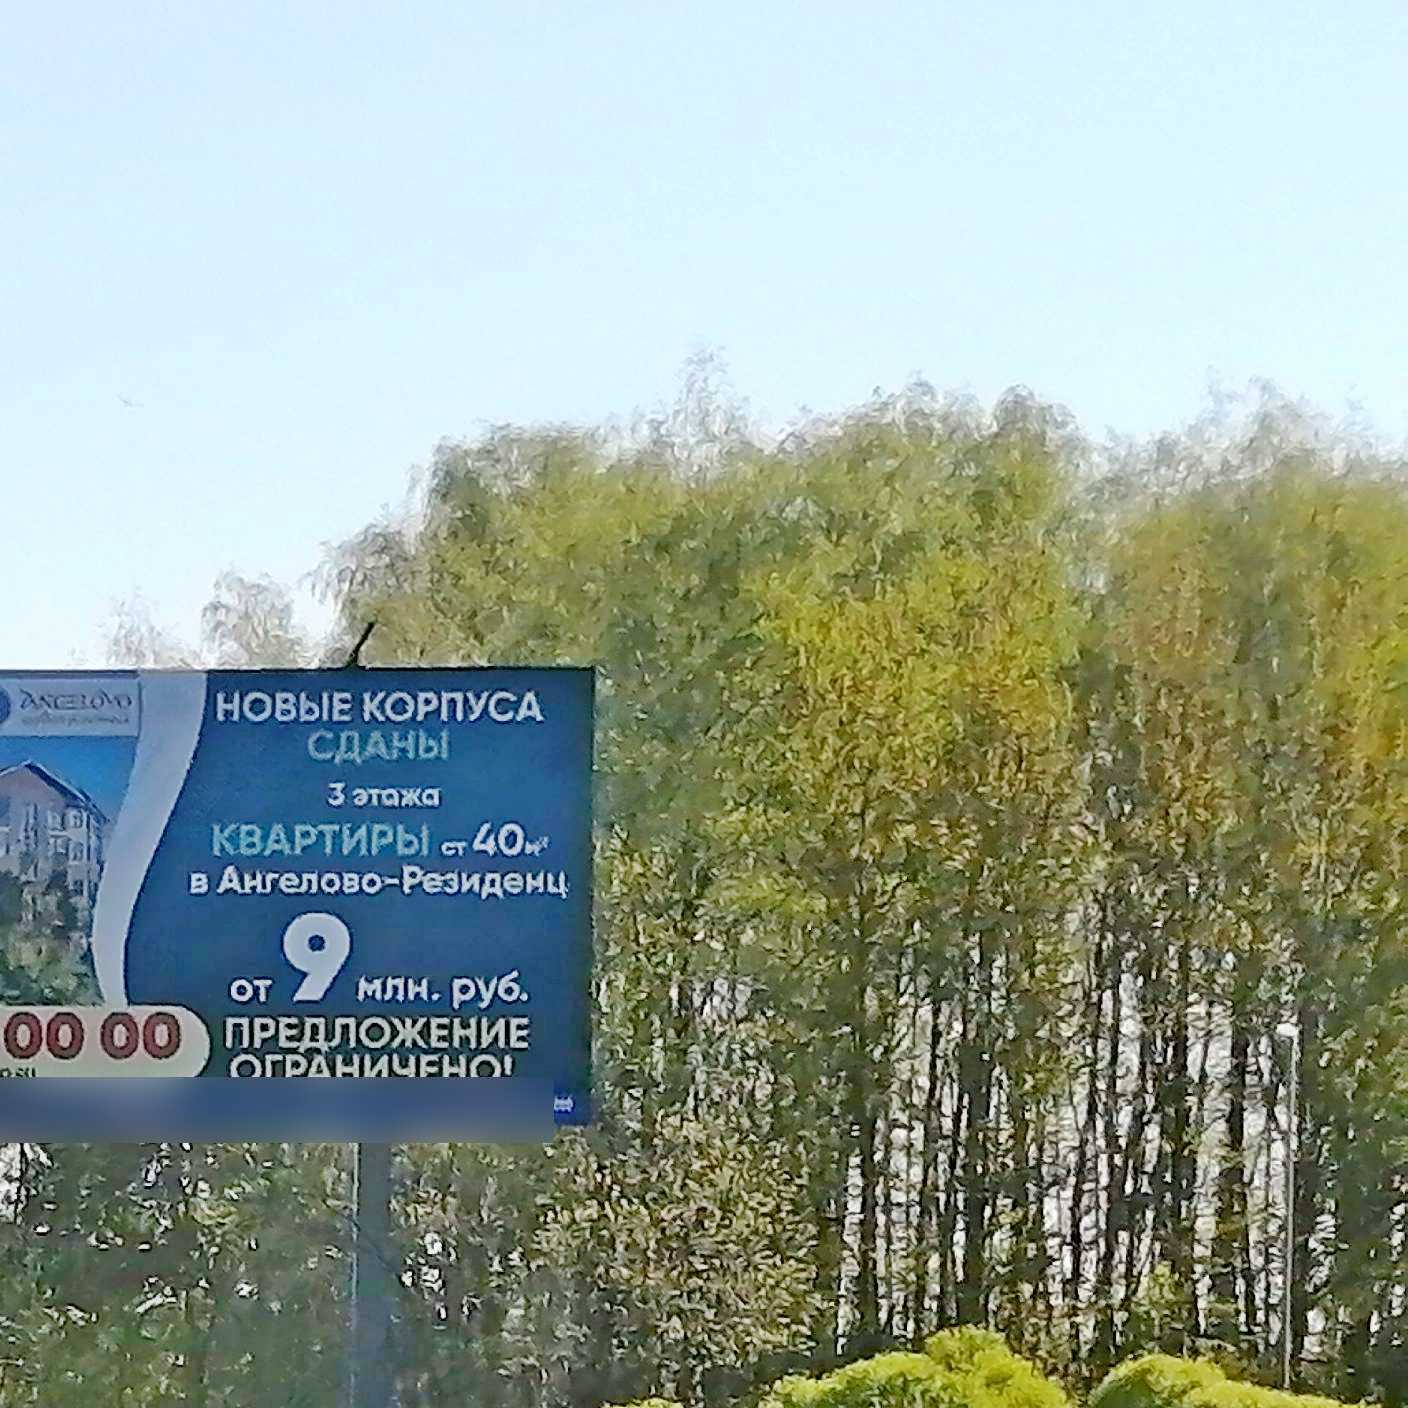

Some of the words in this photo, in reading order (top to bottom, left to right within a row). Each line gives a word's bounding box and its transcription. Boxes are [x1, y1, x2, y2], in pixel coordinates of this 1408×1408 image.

[215, 690, 353, 722] НОВЫЕ
[362, 690, 545, 723] КОРПУСА
[306, 728, 450, 765] СДАНЫ
[327, 782, 347, 808] 3
[352, 786, 441, 808] этажа
[211, 822, 430, 857] КВАРТИРЫ
[190, 872, 209, 894] в
[229, 978, 273, 1002] от
[282, 911, 352, 1002] 9
[357, 975, 441, 1003] млн.
[451, 969, 529, 1009] руб.
[2, 1011, 85, 1060] 00
[99, 1011, 182, 1060] 00
[225, 1016, 529, 1053] ПРЕДЛОЖЕНИЕ
[229, 1053, 514, 1077] ОГРАНИЧЕНО!
